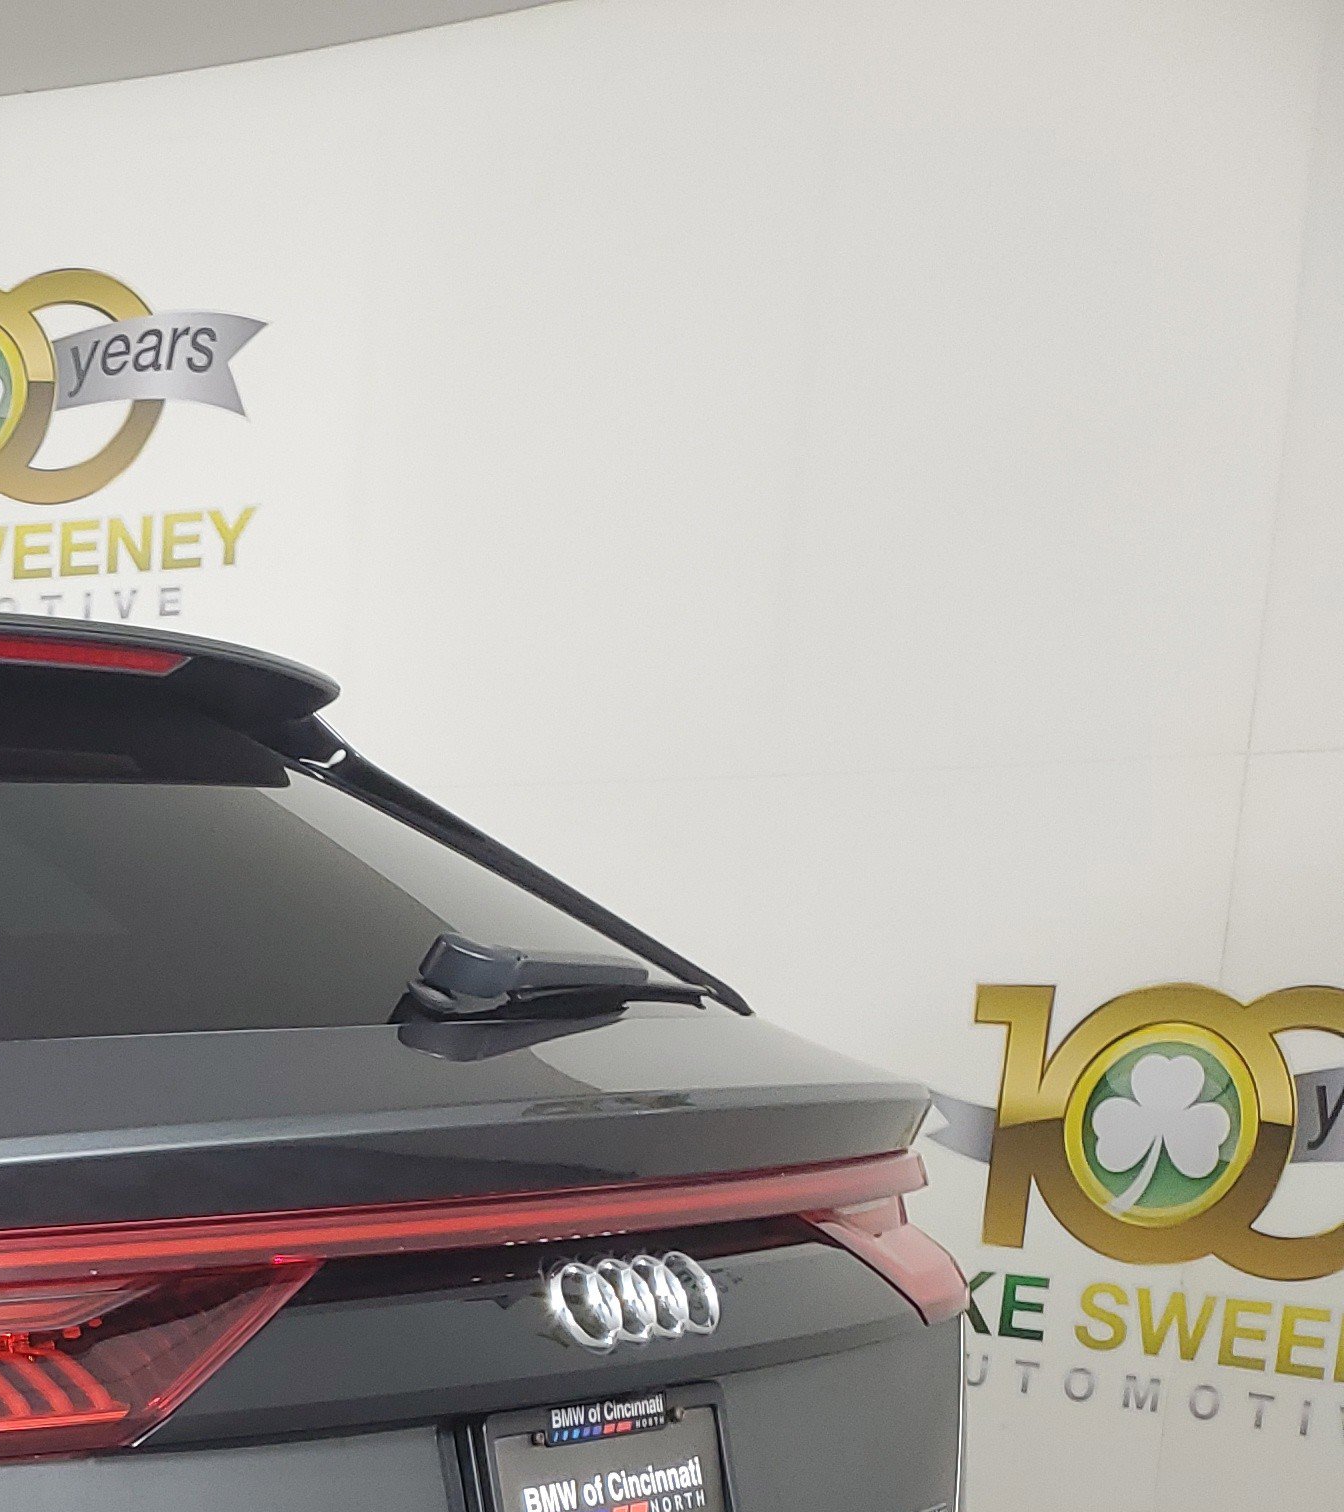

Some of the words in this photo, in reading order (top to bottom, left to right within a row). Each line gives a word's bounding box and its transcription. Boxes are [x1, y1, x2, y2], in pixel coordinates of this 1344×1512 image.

[68, 323, 216, 397] years
[1074, 1283, 1344, 1383] SWEE
[551, 1405, 585, 1429] BMW
[588, 1403, 602, 1424] of
[603, 1394, 665, 1421] Cincinnati
[583, 1475, 605, 1506] of
[607, 1456, 703, 1501] Cincinnati
